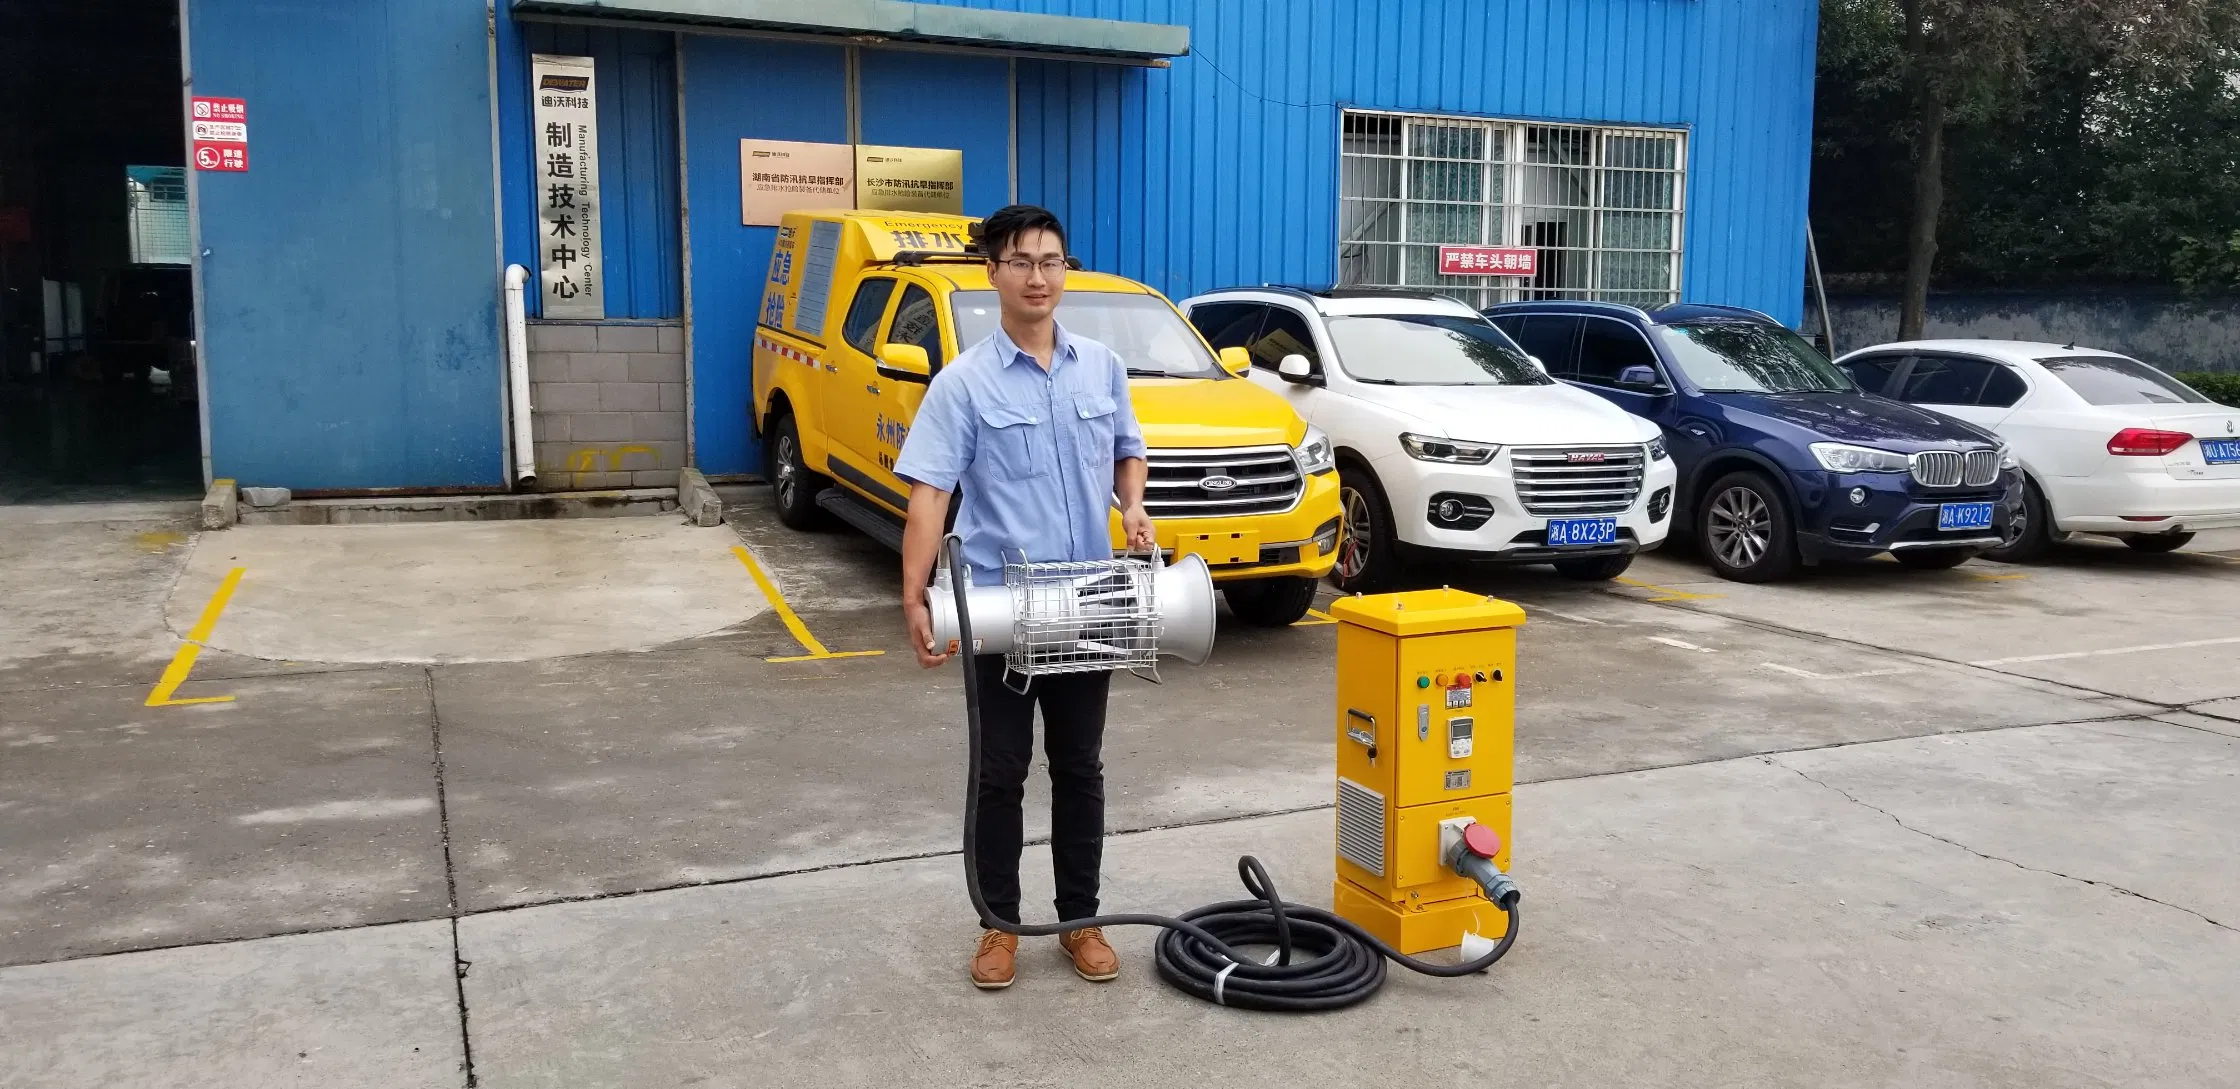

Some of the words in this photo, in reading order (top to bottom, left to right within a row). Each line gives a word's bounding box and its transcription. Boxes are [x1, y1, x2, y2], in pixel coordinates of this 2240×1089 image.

[543, 78, 587, 88] DEWATER
[213, 102, 244, 113] 禁止吸烟
[541, 96, 589, 109] 迪沃科技
[223, 148, 243, 158] 限速
[224, 159, 244, 168] 行驶
[577, 124, 591, 197] Manufacturing
[752, 172, 844, 186] 湖南省防汛抗旱指挥部
[867, 177, 954, 191] 长沙市防汛抗旱指挥部
[545, 121, 580, 299] 制造技术中心
[580, 202, 592, 259] Technology
[884, 221, 963, 230] Emergency
[771, 249, 792, 286] 应急
[1445, 252, 1532, 270] 严禁车头朝墙
[583, 263, 593, 297] Center
[765, 291, 786, 328] 抢险
[876, 411, 910, 450] 永州防
[1570, 453, 1604, 461] HAVAL
